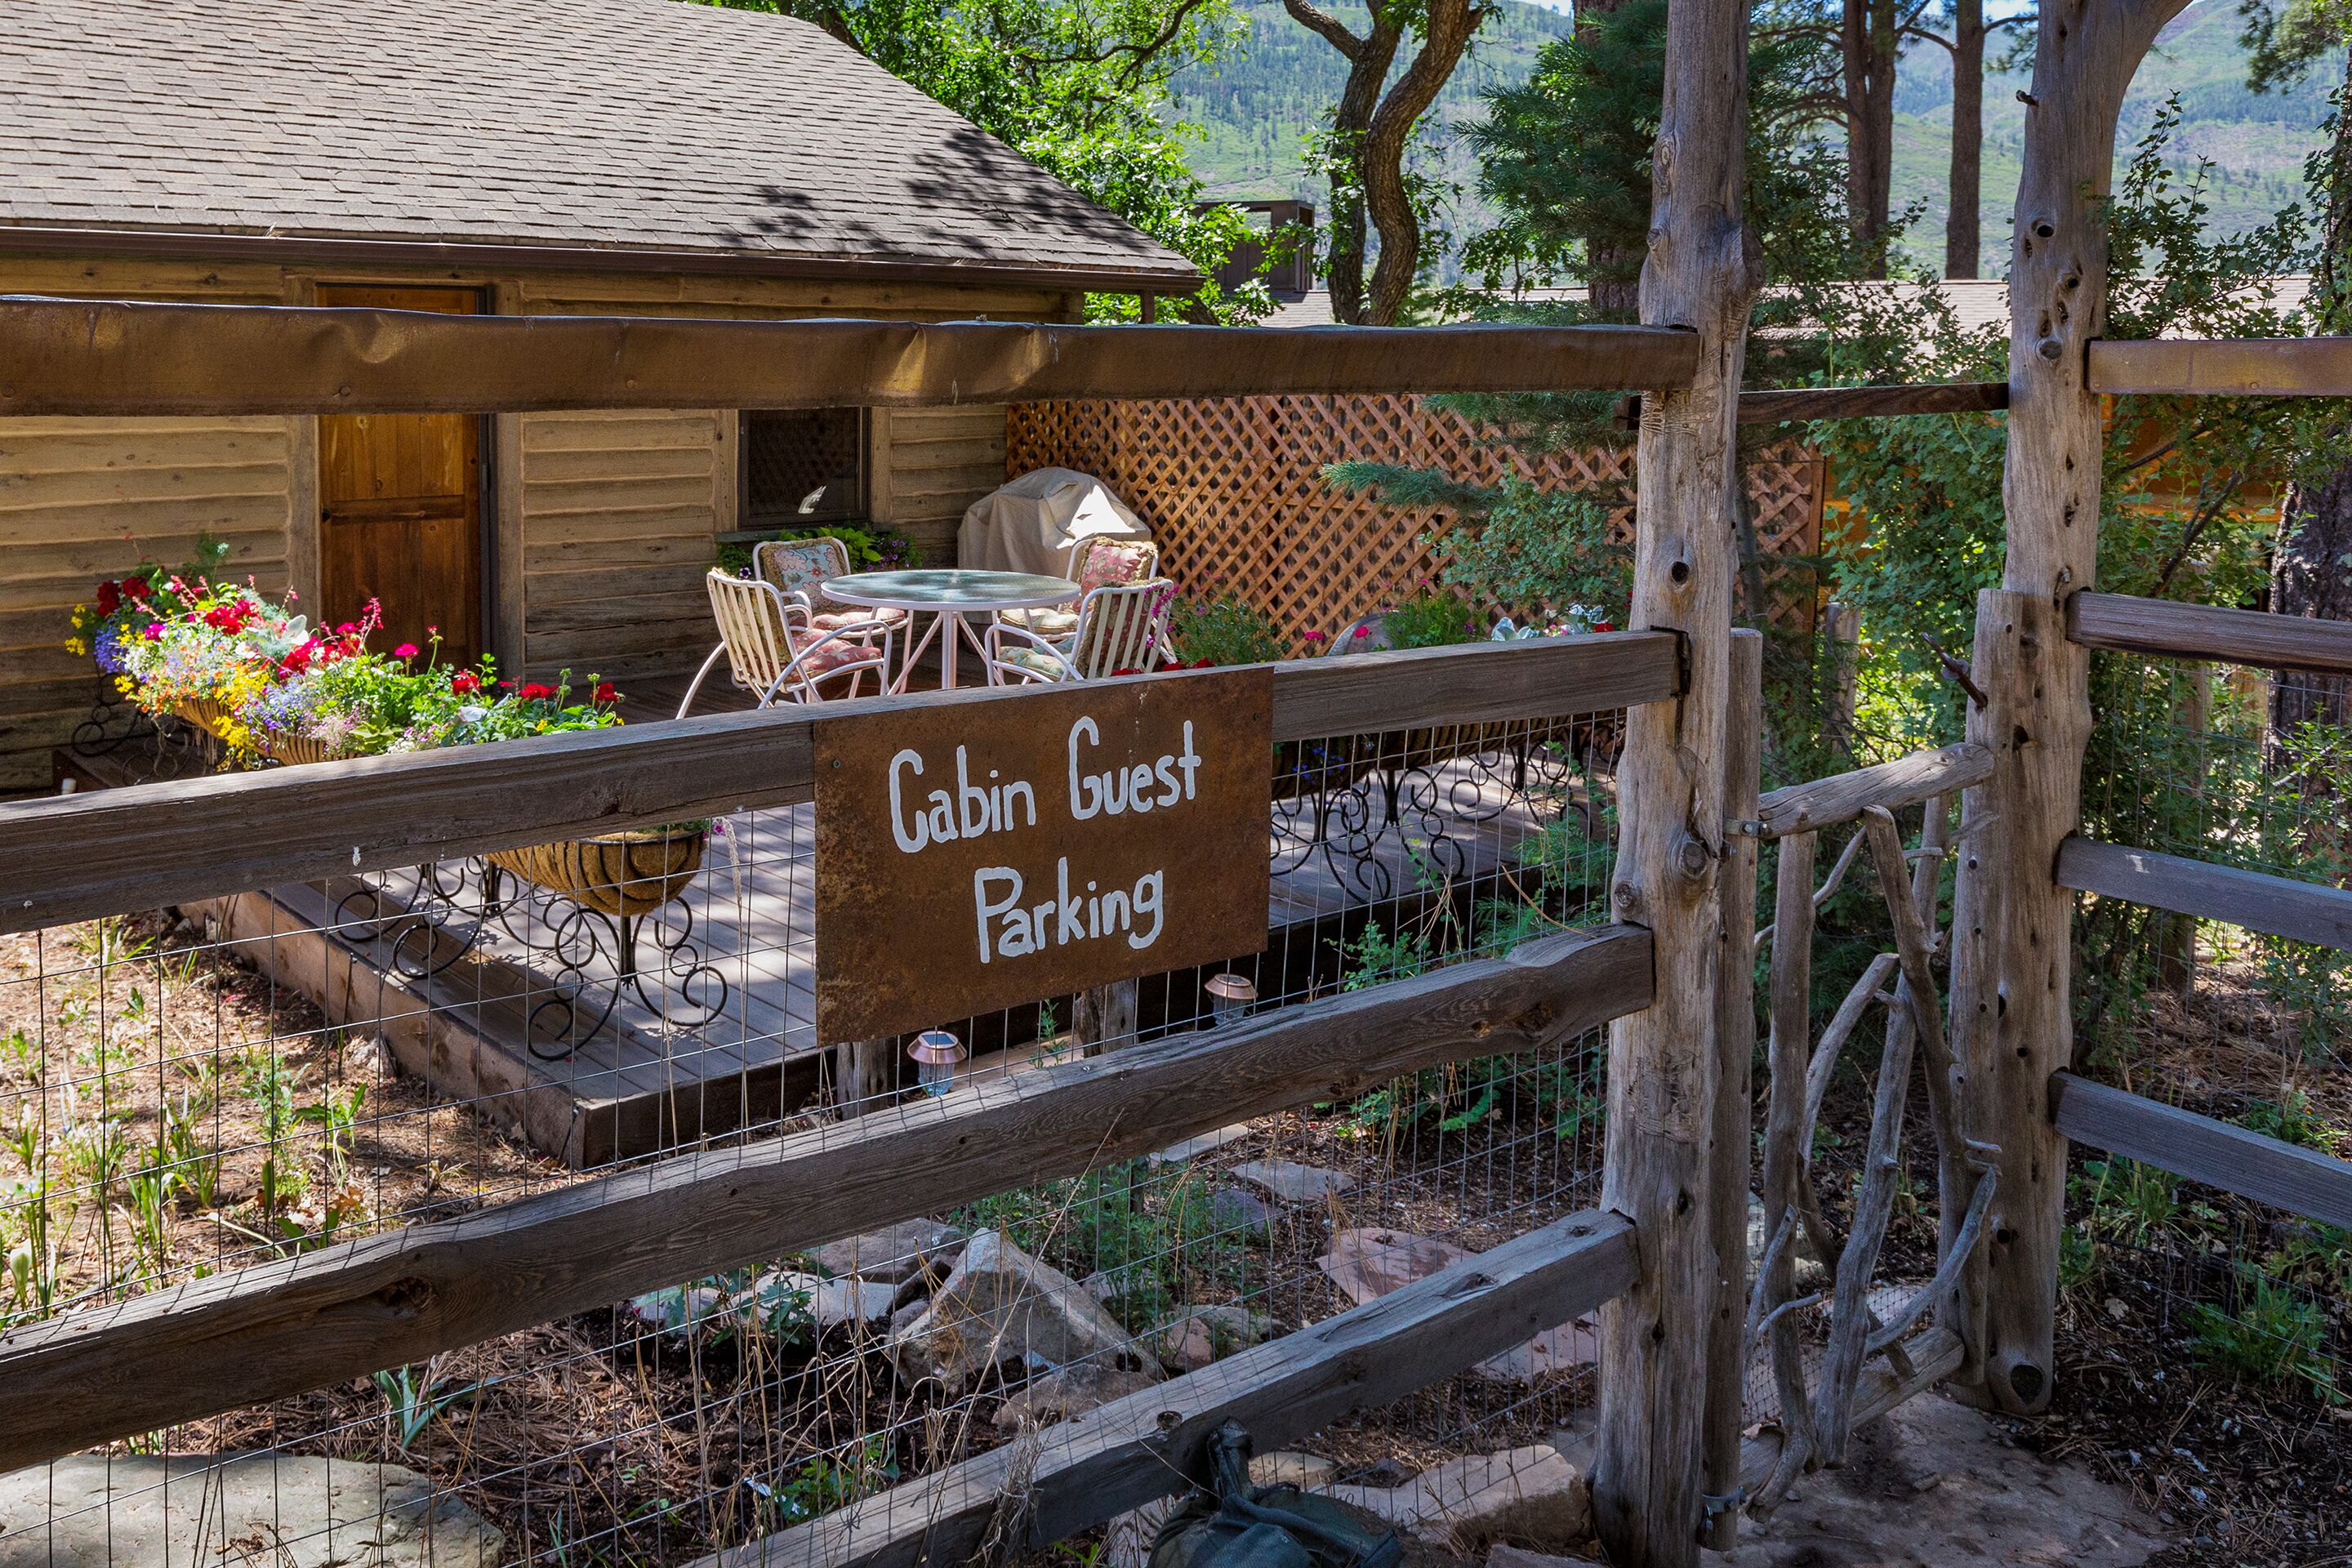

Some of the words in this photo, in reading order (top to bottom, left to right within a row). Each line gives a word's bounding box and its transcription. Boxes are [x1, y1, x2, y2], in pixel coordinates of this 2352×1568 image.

[889, 745, 1036, 853] Cabin
[1069, 716, 1201, 820] Guest
[974, 857, 1163, 964] Parking
